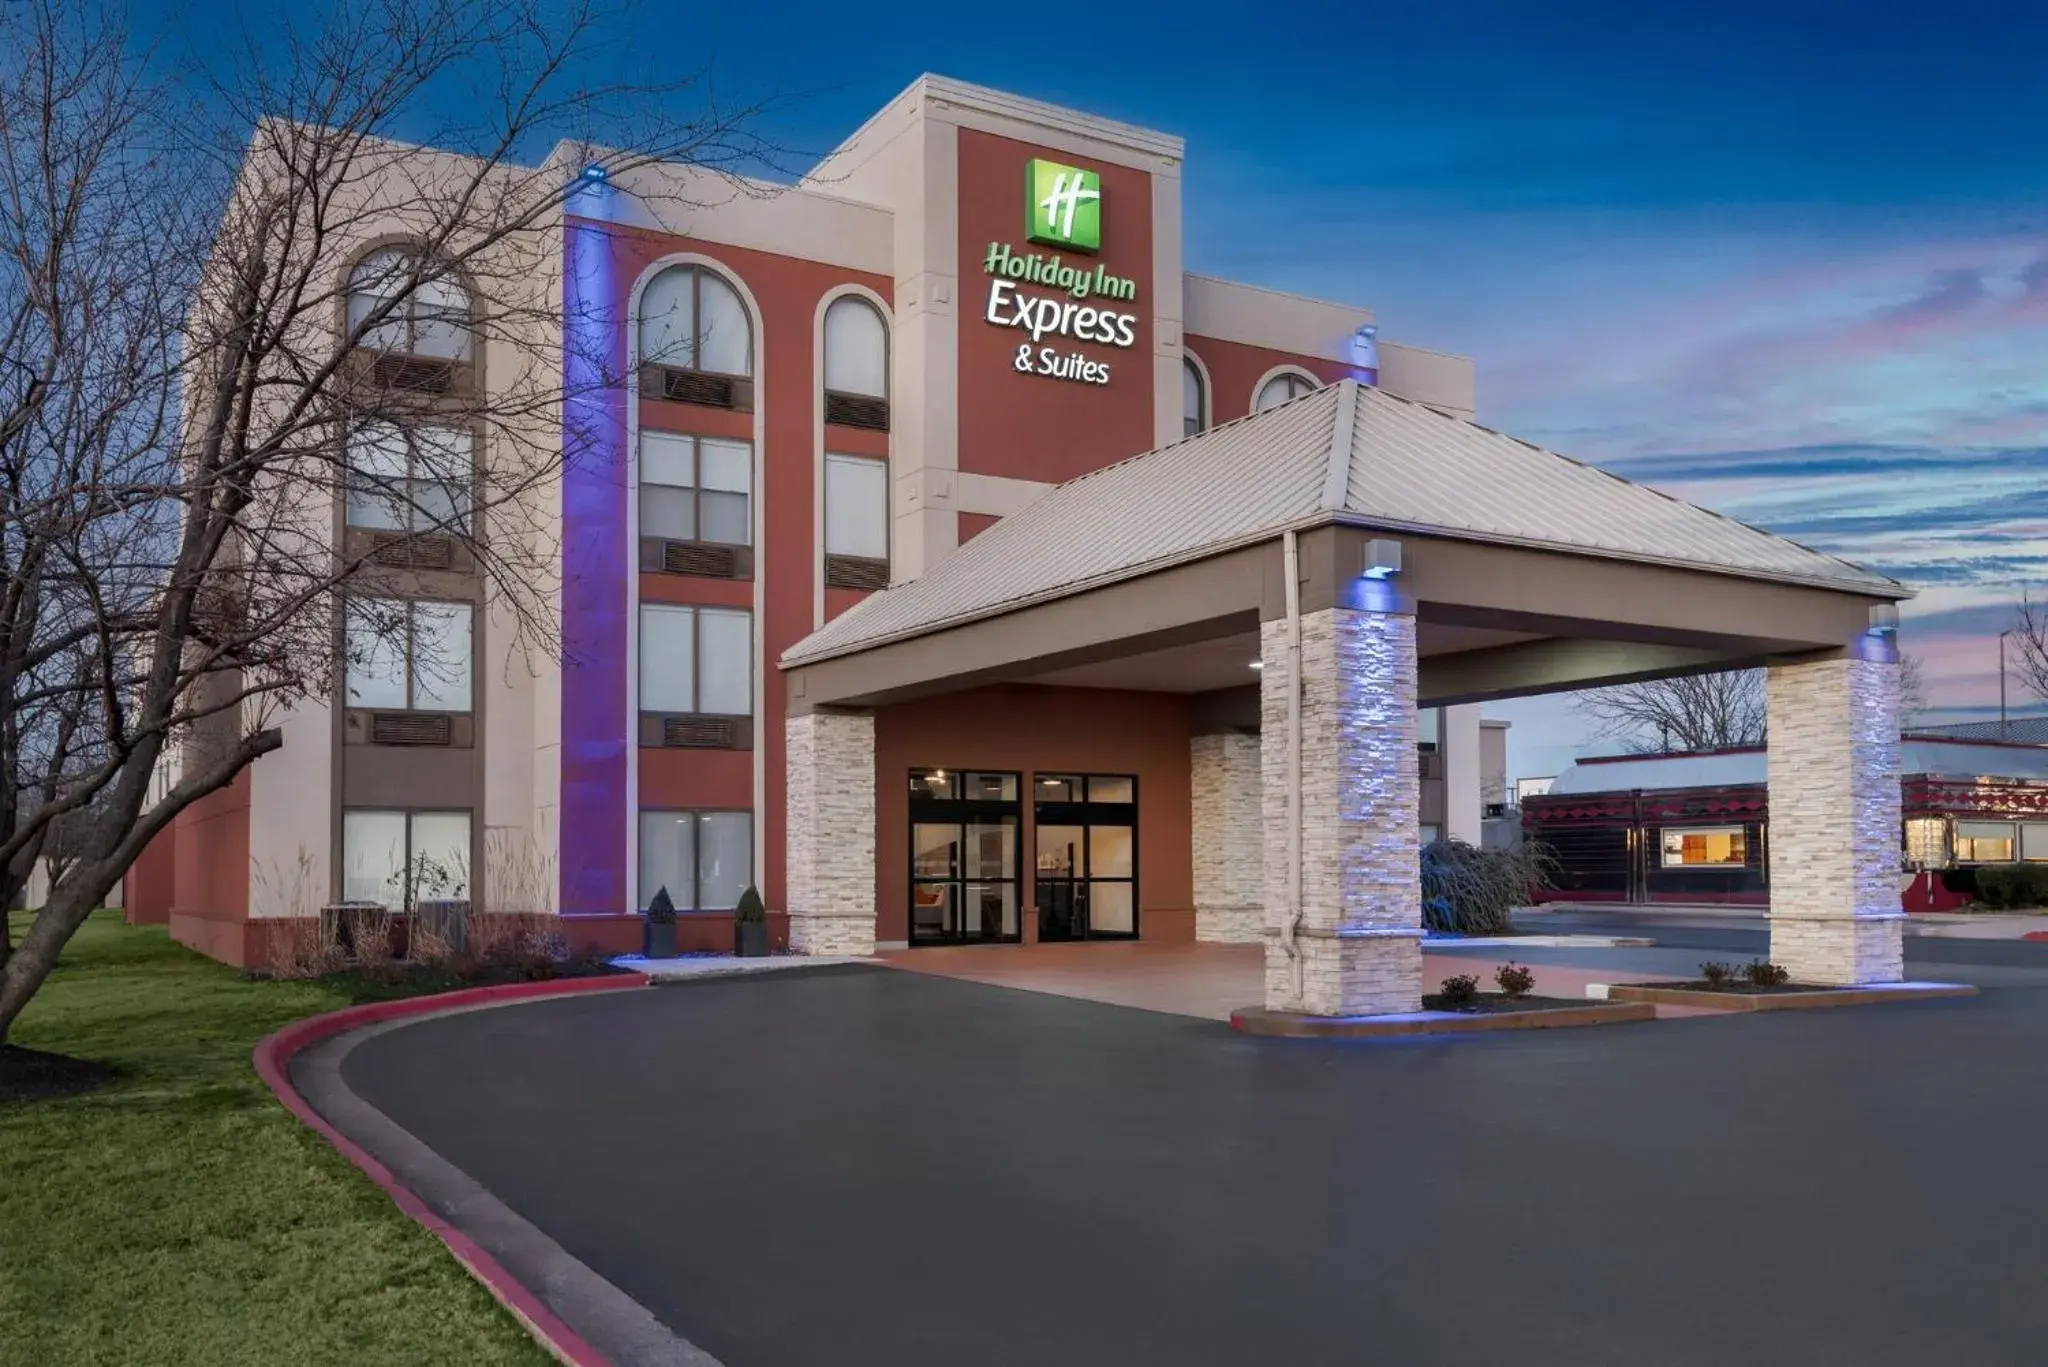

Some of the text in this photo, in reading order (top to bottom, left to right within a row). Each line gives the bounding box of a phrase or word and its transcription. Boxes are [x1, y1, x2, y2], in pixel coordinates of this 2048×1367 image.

[1040, 173, 1100, 238] H
[984, 242, 1135, 300] Holiday Inn
[987, 280, 1136, 346] Express
[1015, 345, 1109, 384] & Suites
